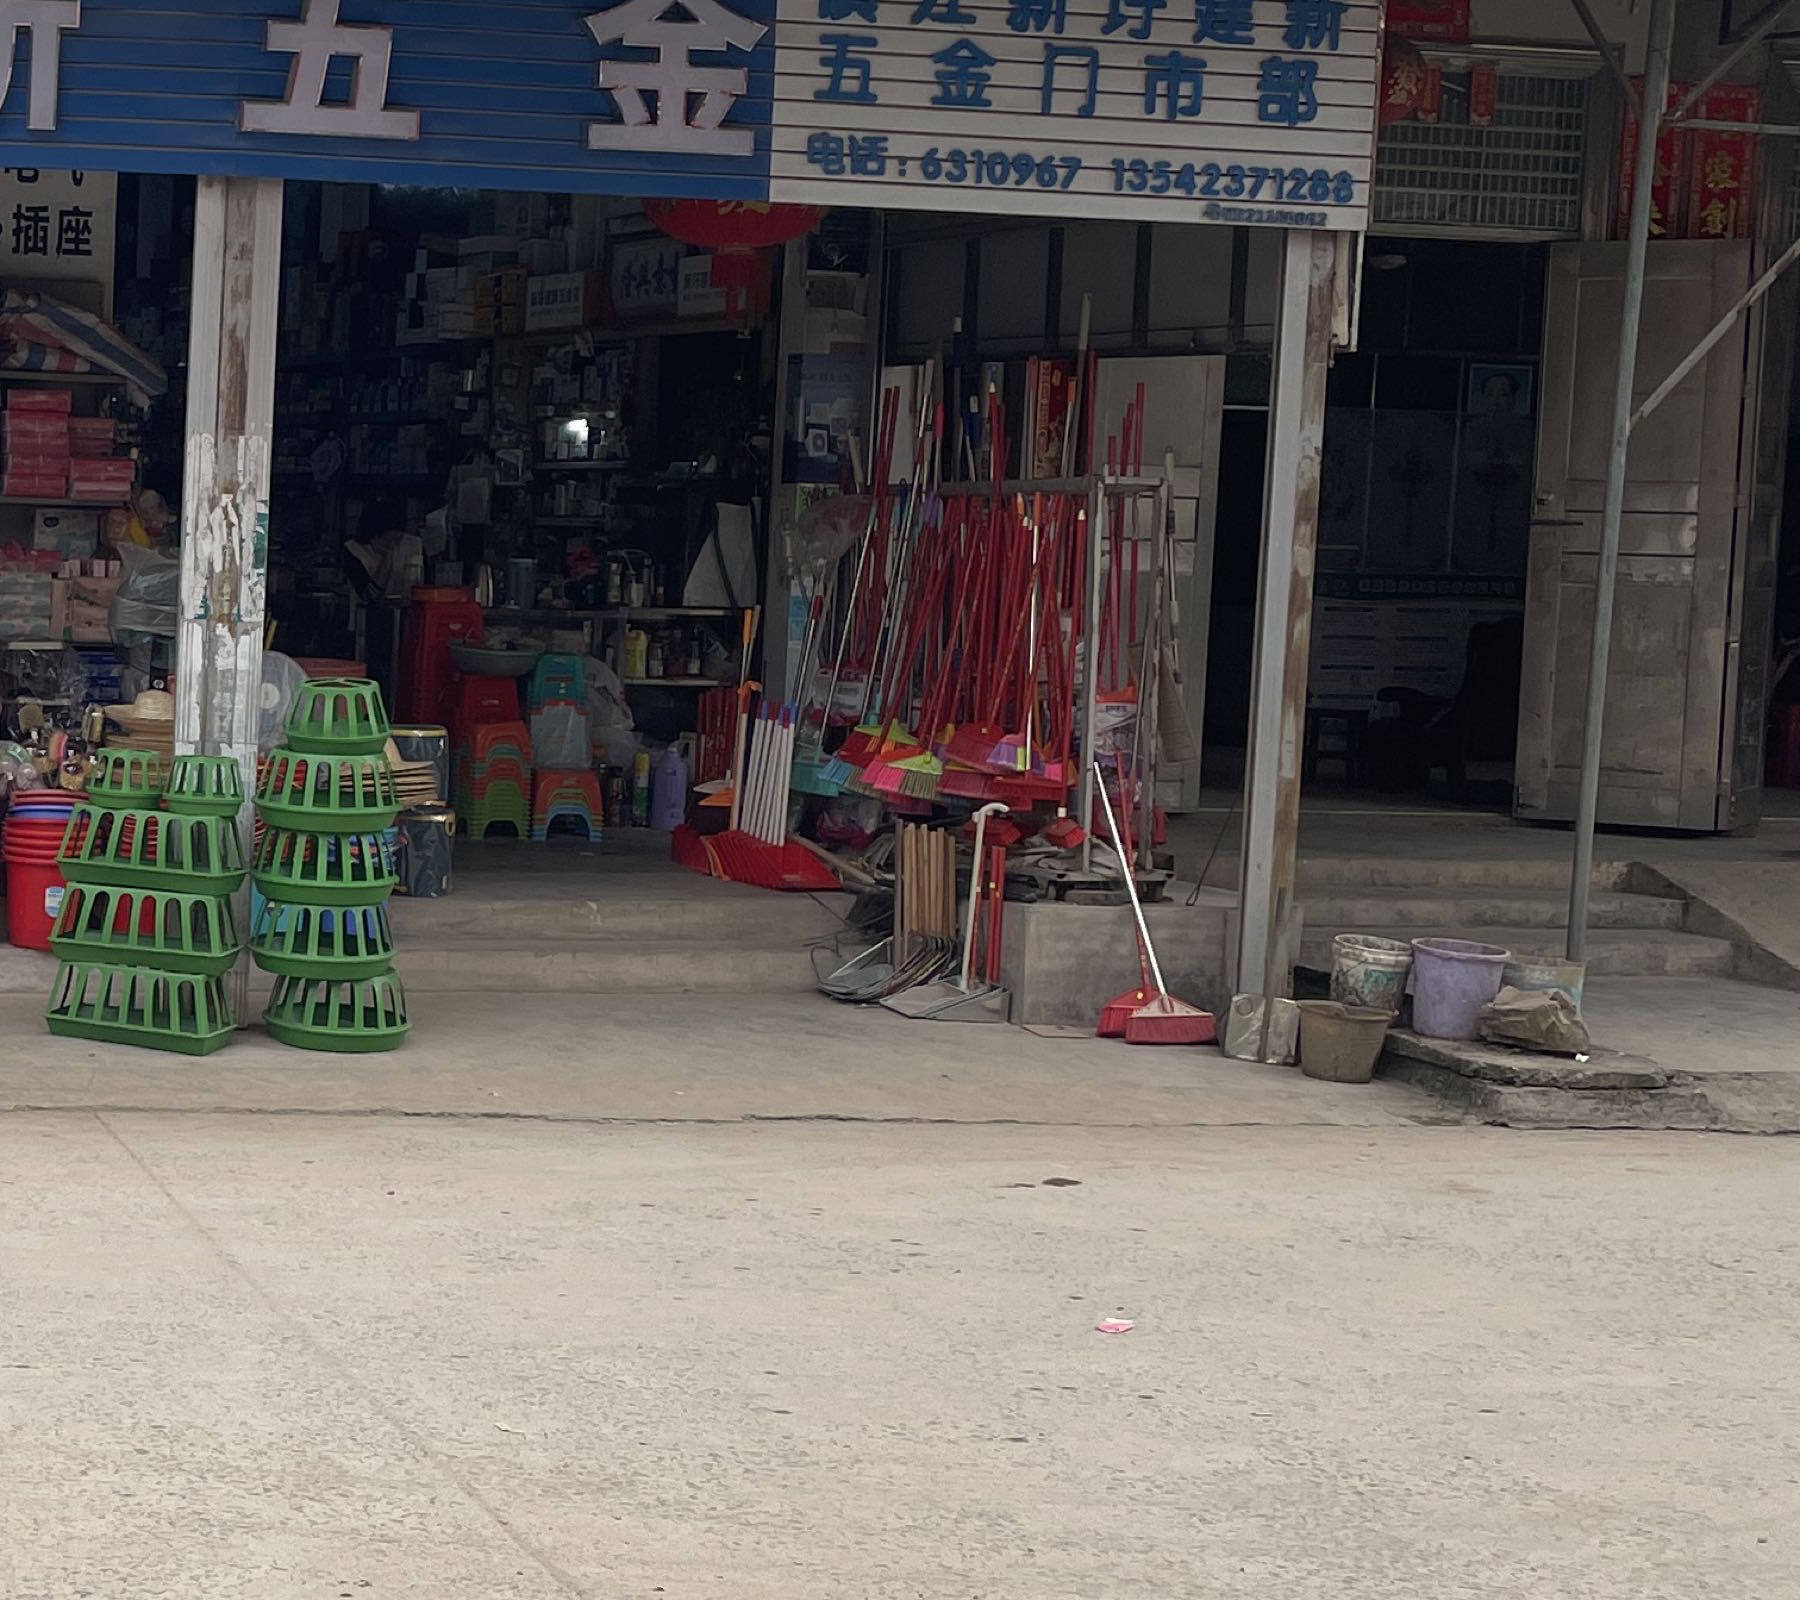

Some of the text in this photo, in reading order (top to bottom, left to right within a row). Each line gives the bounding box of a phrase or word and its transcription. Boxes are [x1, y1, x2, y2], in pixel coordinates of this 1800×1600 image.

[813, 32, 1320, 128] 五金门市部
[1110, 157, 1354, 204] 13542371288
